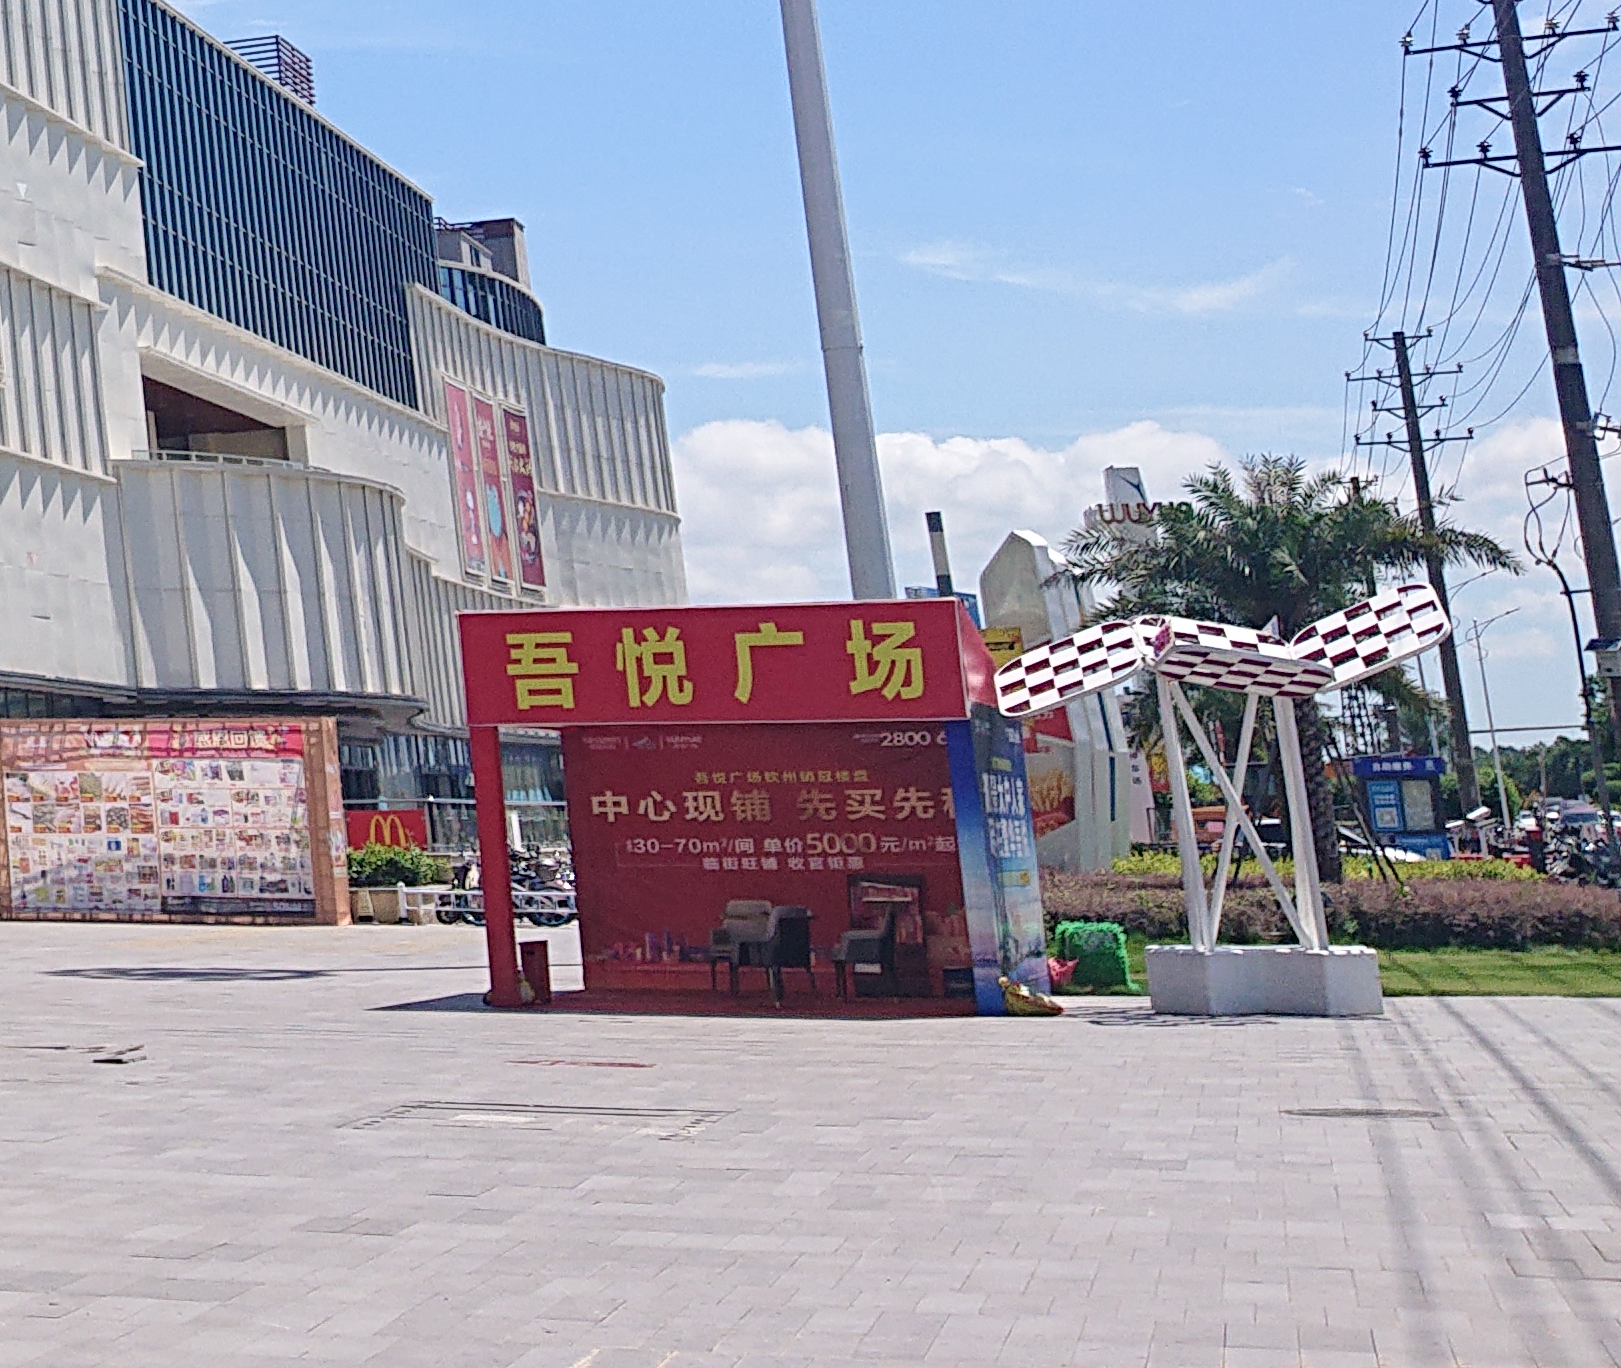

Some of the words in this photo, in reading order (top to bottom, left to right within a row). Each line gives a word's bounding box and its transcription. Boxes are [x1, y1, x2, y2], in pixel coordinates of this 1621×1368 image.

[505, 618, 925, 711] 吾悦广场
[879, 731, 932, 747] 2800
[590, 789, 773, 823] 中心现铺
